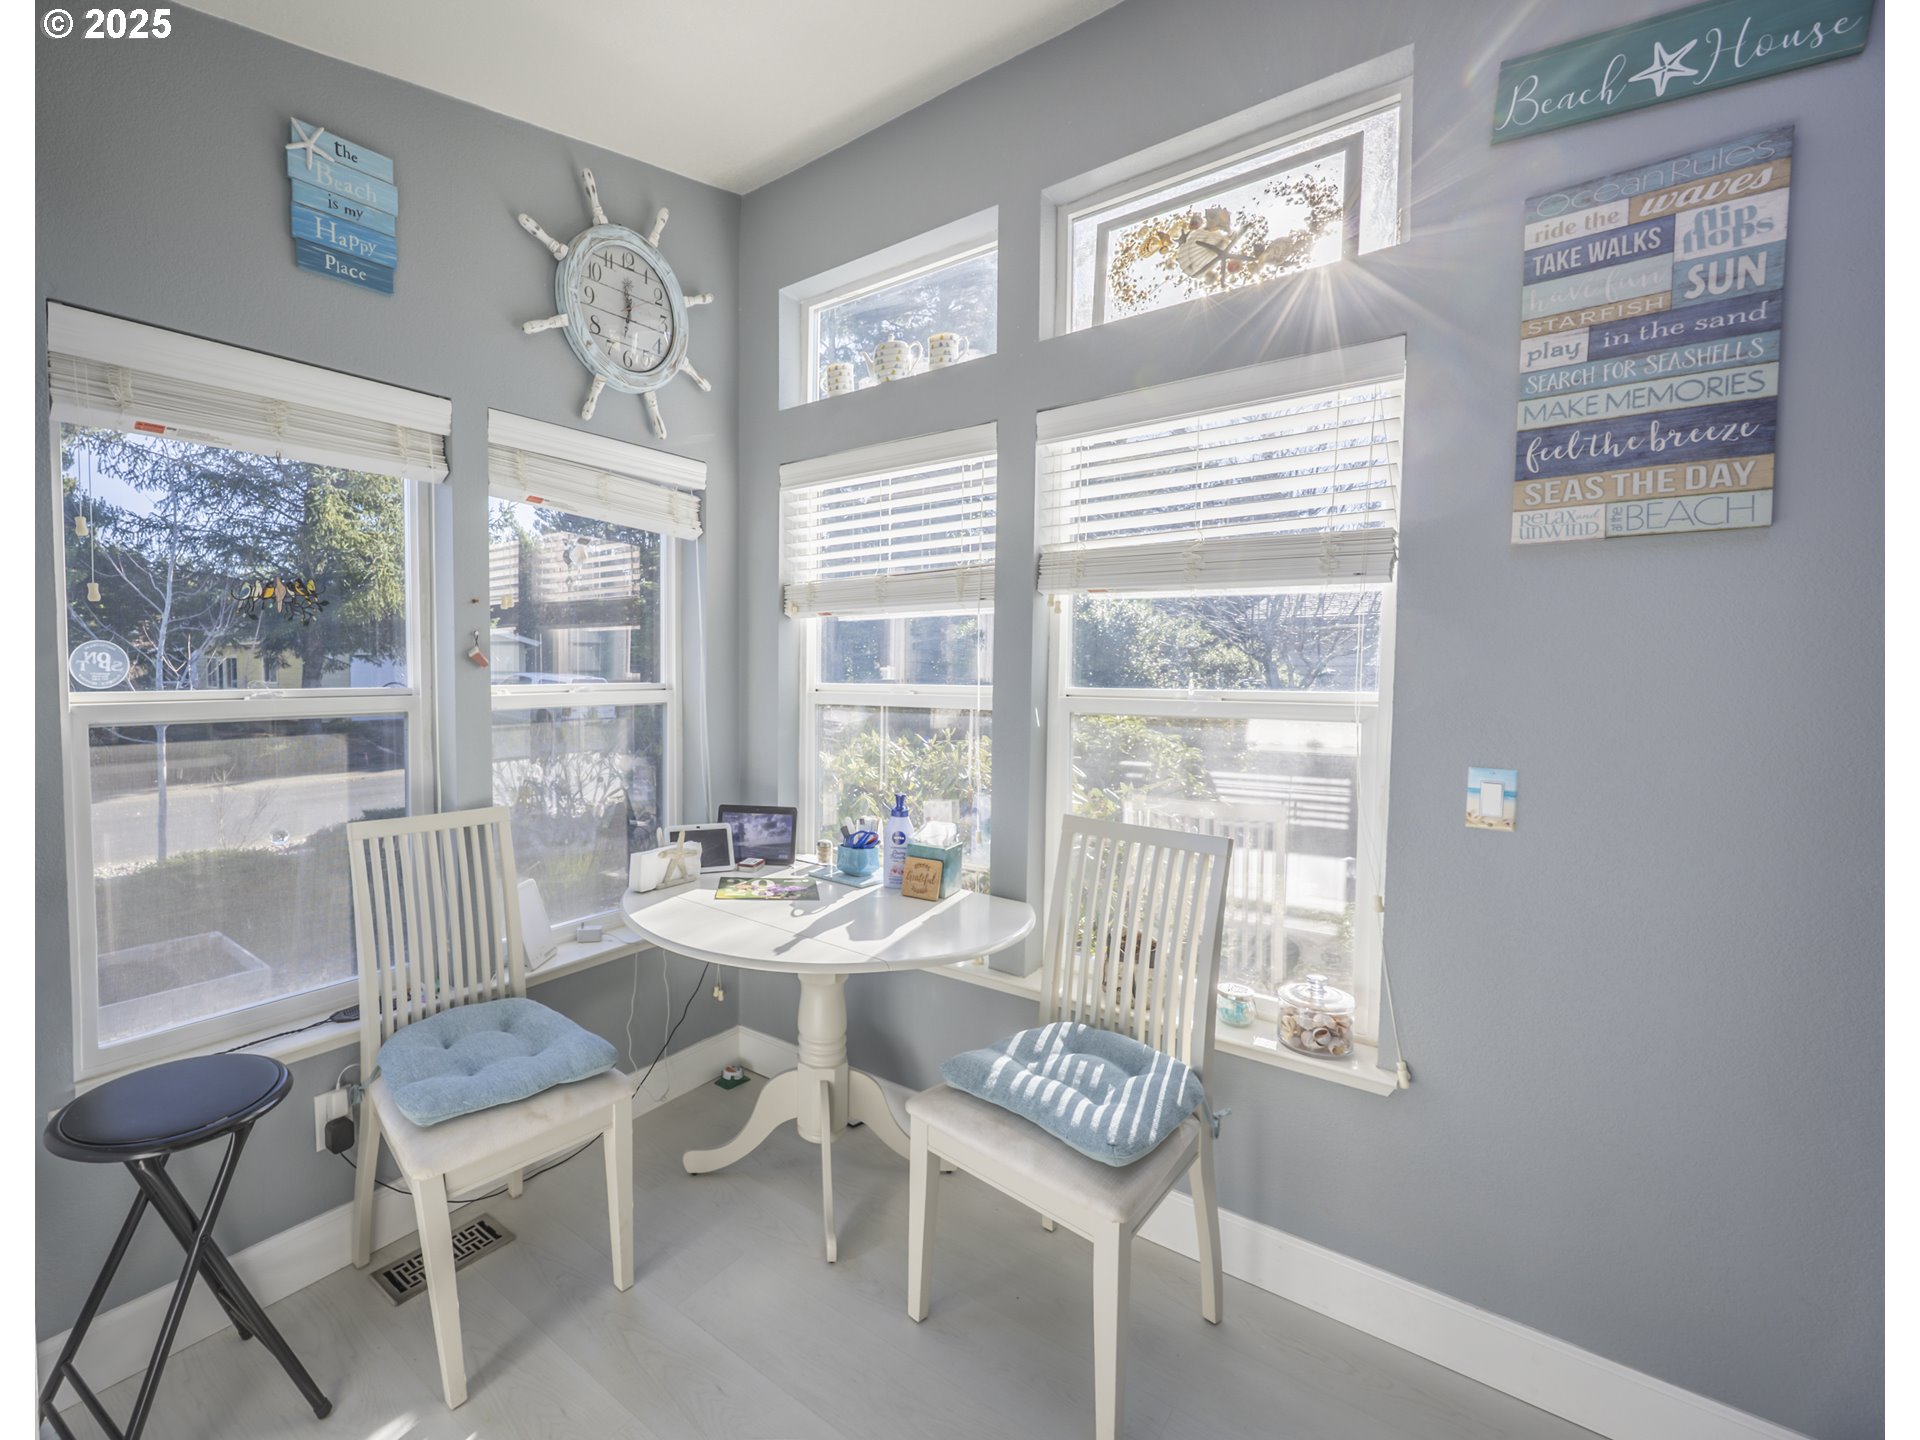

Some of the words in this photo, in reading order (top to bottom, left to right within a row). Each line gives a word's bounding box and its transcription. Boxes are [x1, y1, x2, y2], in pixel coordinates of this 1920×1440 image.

[1496, 54, 1629, 131] Beach
[1693, 16, 1863, 86] House
[334, 141, 358, 163] the
[316, 161, 377, 203] Beach
[1536, 168, 1665, 217] Ocean
[1671, 139, 1776, 182] Rules
[328, 193, 339, 210] is
[344, 206, 364, 221] my
[1534, 219, 1577, 243] ride
[1584, 210, 1620, 232] the
[1639, 166, 1774, 217] waves
[1694, 204, 1758, 231] flip
[1682, 217, 1775, 254] flops
[603, 250, 613, 270] 11
[621, 252, 635, 272] 12
[1532, 245, 1582, 277] TAKE
[1588, 227, 1662, 264] WALKS
[324, 253, 367, 281] Place
[588, 261, 602, 282] 10
[644, 268, 648, 285] 1
[1683, 251, 1767, 299] SUN
[584, 285, 595, 305] 9
[653, 287, 663, 306] 2
[1529, 277, 1598, 312] have
[1604, 268, 1667, 303] fun
[590, 315, 601, 335] 8
[660, 315, 668, 332] 3
[1527, 296, 1665, 336] STARFISH
[606, 339, 615, 355] 7
[652, 337, 661, 355] 4
[1527, 341, 1581, 368] play
[1603, 331, 1629, 349] in
[1639, 321, 1685, 342] the
[1695, 300, 1769, 331] sand
[622, 350, 633, 368] 6
[643, 350, 651, 366] 5
[1525, 366, 1595, 396] SEARCH
[1603, 360, 1637, 382] FOR
[1643, 337, 1765, 376] SEASHELLS
[1523, 394, 1600, 426] MAKE
[1605, 369, 1766, 413] MEMORIES
[1525, 430, 1585, 474] feel
[1584, 430, 1646, 458] the
[1650, 420, 1761, 453] breeze
[1524, 475, 1604, 507] SEAS
[1611, 468, 1676, 497] THE
[1685, 459, 1757, 490] DAY
[1626, 494, 1756, 532] BEACH
[905, 870, 937, 886] Grateful
